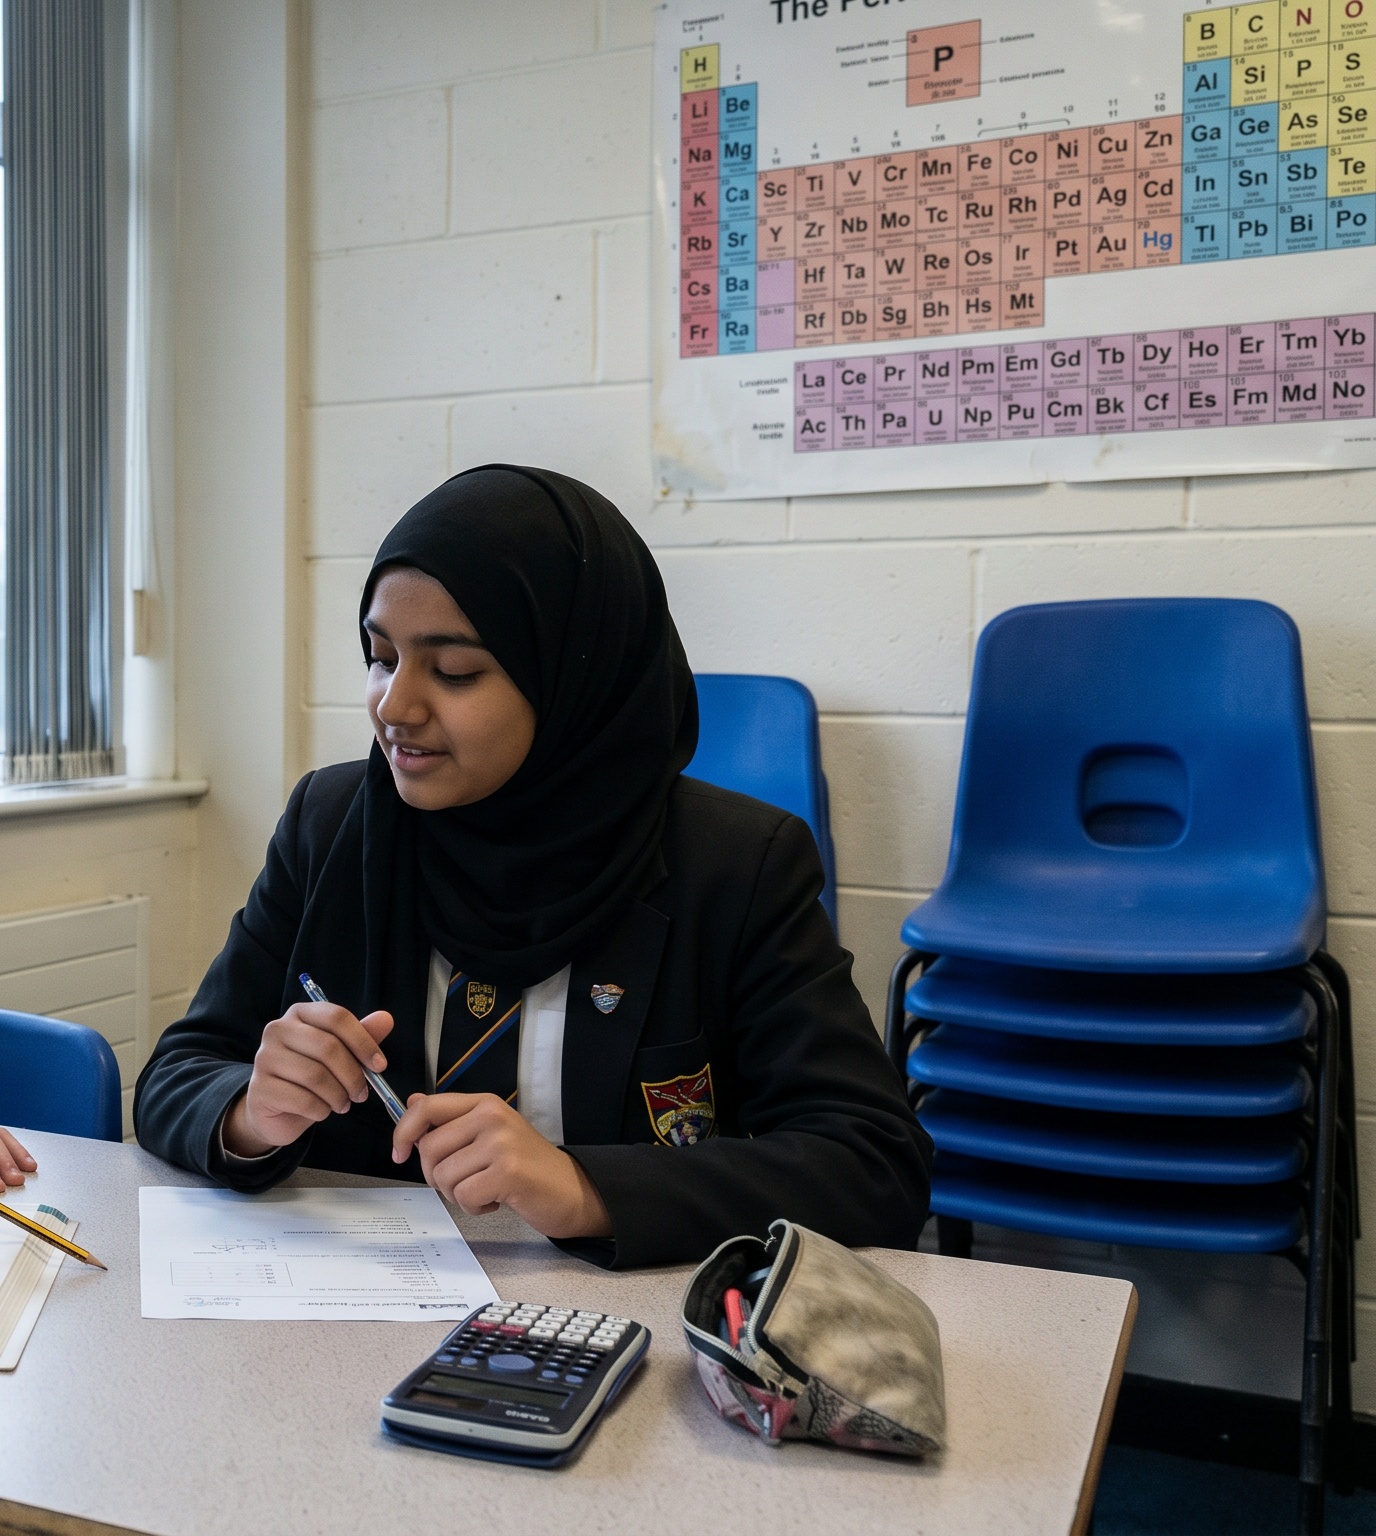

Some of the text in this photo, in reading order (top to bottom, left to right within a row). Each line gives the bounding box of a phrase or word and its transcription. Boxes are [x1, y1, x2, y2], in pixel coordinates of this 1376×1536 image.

[771, 0, 828, 23] The
[1201, 0, 1363, 40] B C N O
[694, 57, 706, 72] H
[934, 46, 953, 71] P
[1195, 53, 1360, 92] Al Si P S
[692, 97, 750, 119] Li Be
[689, 148, 711, 162] Na
[725, 142, 751, 161] Mg
[694, 106, 1367, 207] K Ca Sc Ti V Cr Mn Fe Co Ni Cu Zn Ga Ge As Se
[688, 158, 1365, 252] Rb Sr Y Zr Nb Mo Tc Ru Rh Pd Ag Cd In Sn Sb Te
[687, 210, 1366, 297] Cs Ba Hf Ta W Re Os Ir Pt Au Hg Tl Pb Bi Po
[690, 294, 1033, 339] Fr Ra Rf Db Sg Bh Hs Mt
[803, 374, 825, 388] La
[841, 370, 866, 385] Ce
[885, 366, 905, 382] Pr
[923, 362, 949, 378] Nd
[962, 360, 994, 375] Pm
[1006, 356, 1038, 372] Em
[1051, 350, 1080, 367] Gd
[1098, 348, 1124, 364] Tb
[1143, 345, 1171, 364] Dy
[1189, 341, 1219, 357] Ho
[1240, 337, 1264, 354] Er
[1282, 333, 1317, 350] Tm
[1334, 329, 1365, 346] Yb
[801, 419, 825, 434] Ac
[842, 415, 865, 430] Th
[883, 413, 906, 428] Pa
[929, 410, 942, 426] U
[965, 408, 992, 426] Np
[1008, 404, 1034, 420] Pu
[1048, 401, 1082, 417] Cm
[1096, 398, 1123, 414] Bk
[1145, 393, 1169, 411] Cf
[1189, 392, 1216, 408] Es
[1234, 389, 1267, 405] Fm
[1283, 384, 1316, 402] Md
[1333, 381, 1365, 398] No
